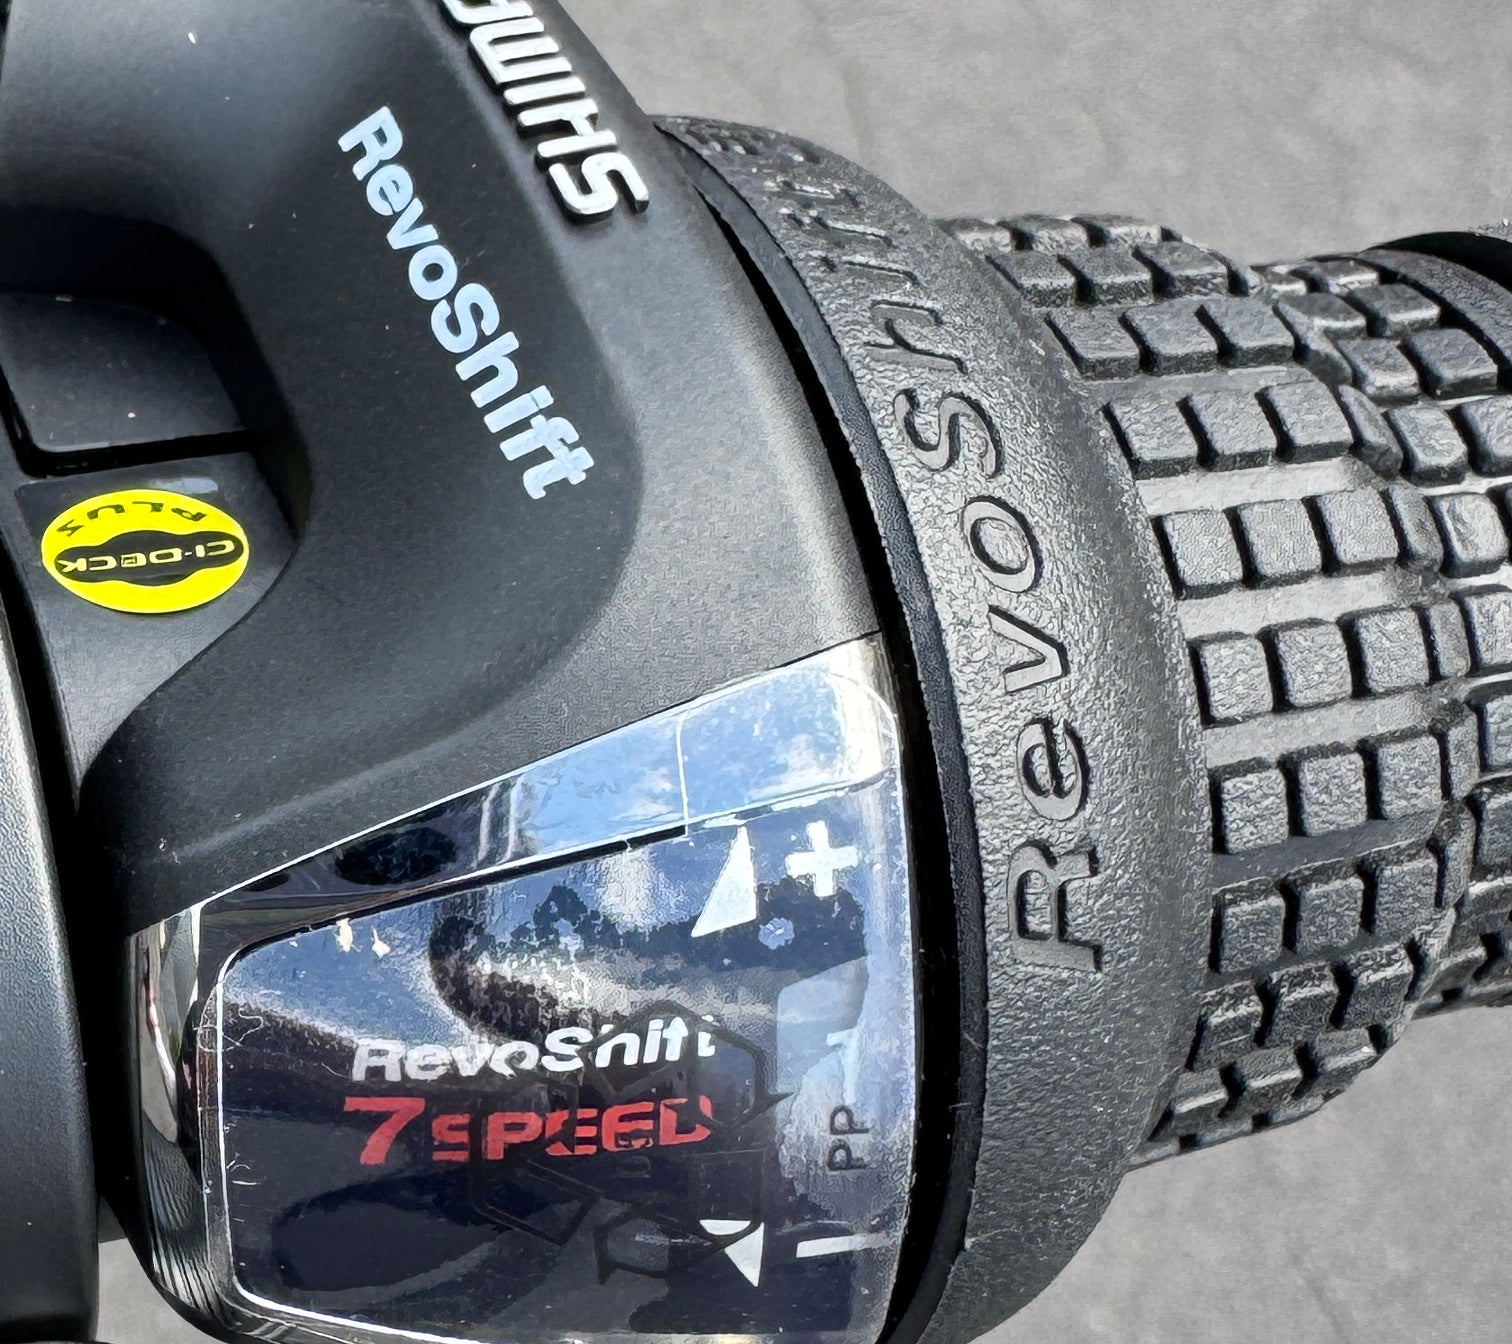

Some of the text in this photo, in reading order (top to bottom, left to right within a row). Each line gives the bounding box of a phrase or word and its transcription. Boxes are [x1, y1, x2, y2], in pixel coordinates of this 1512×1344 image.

[337, 105, 595, 501] RevoShift
[55, 500, 208, 537] PLUS
[57, 539, 236, 573] CI-DECK
[343, 1095, 713, 1166] 7 SPEED
